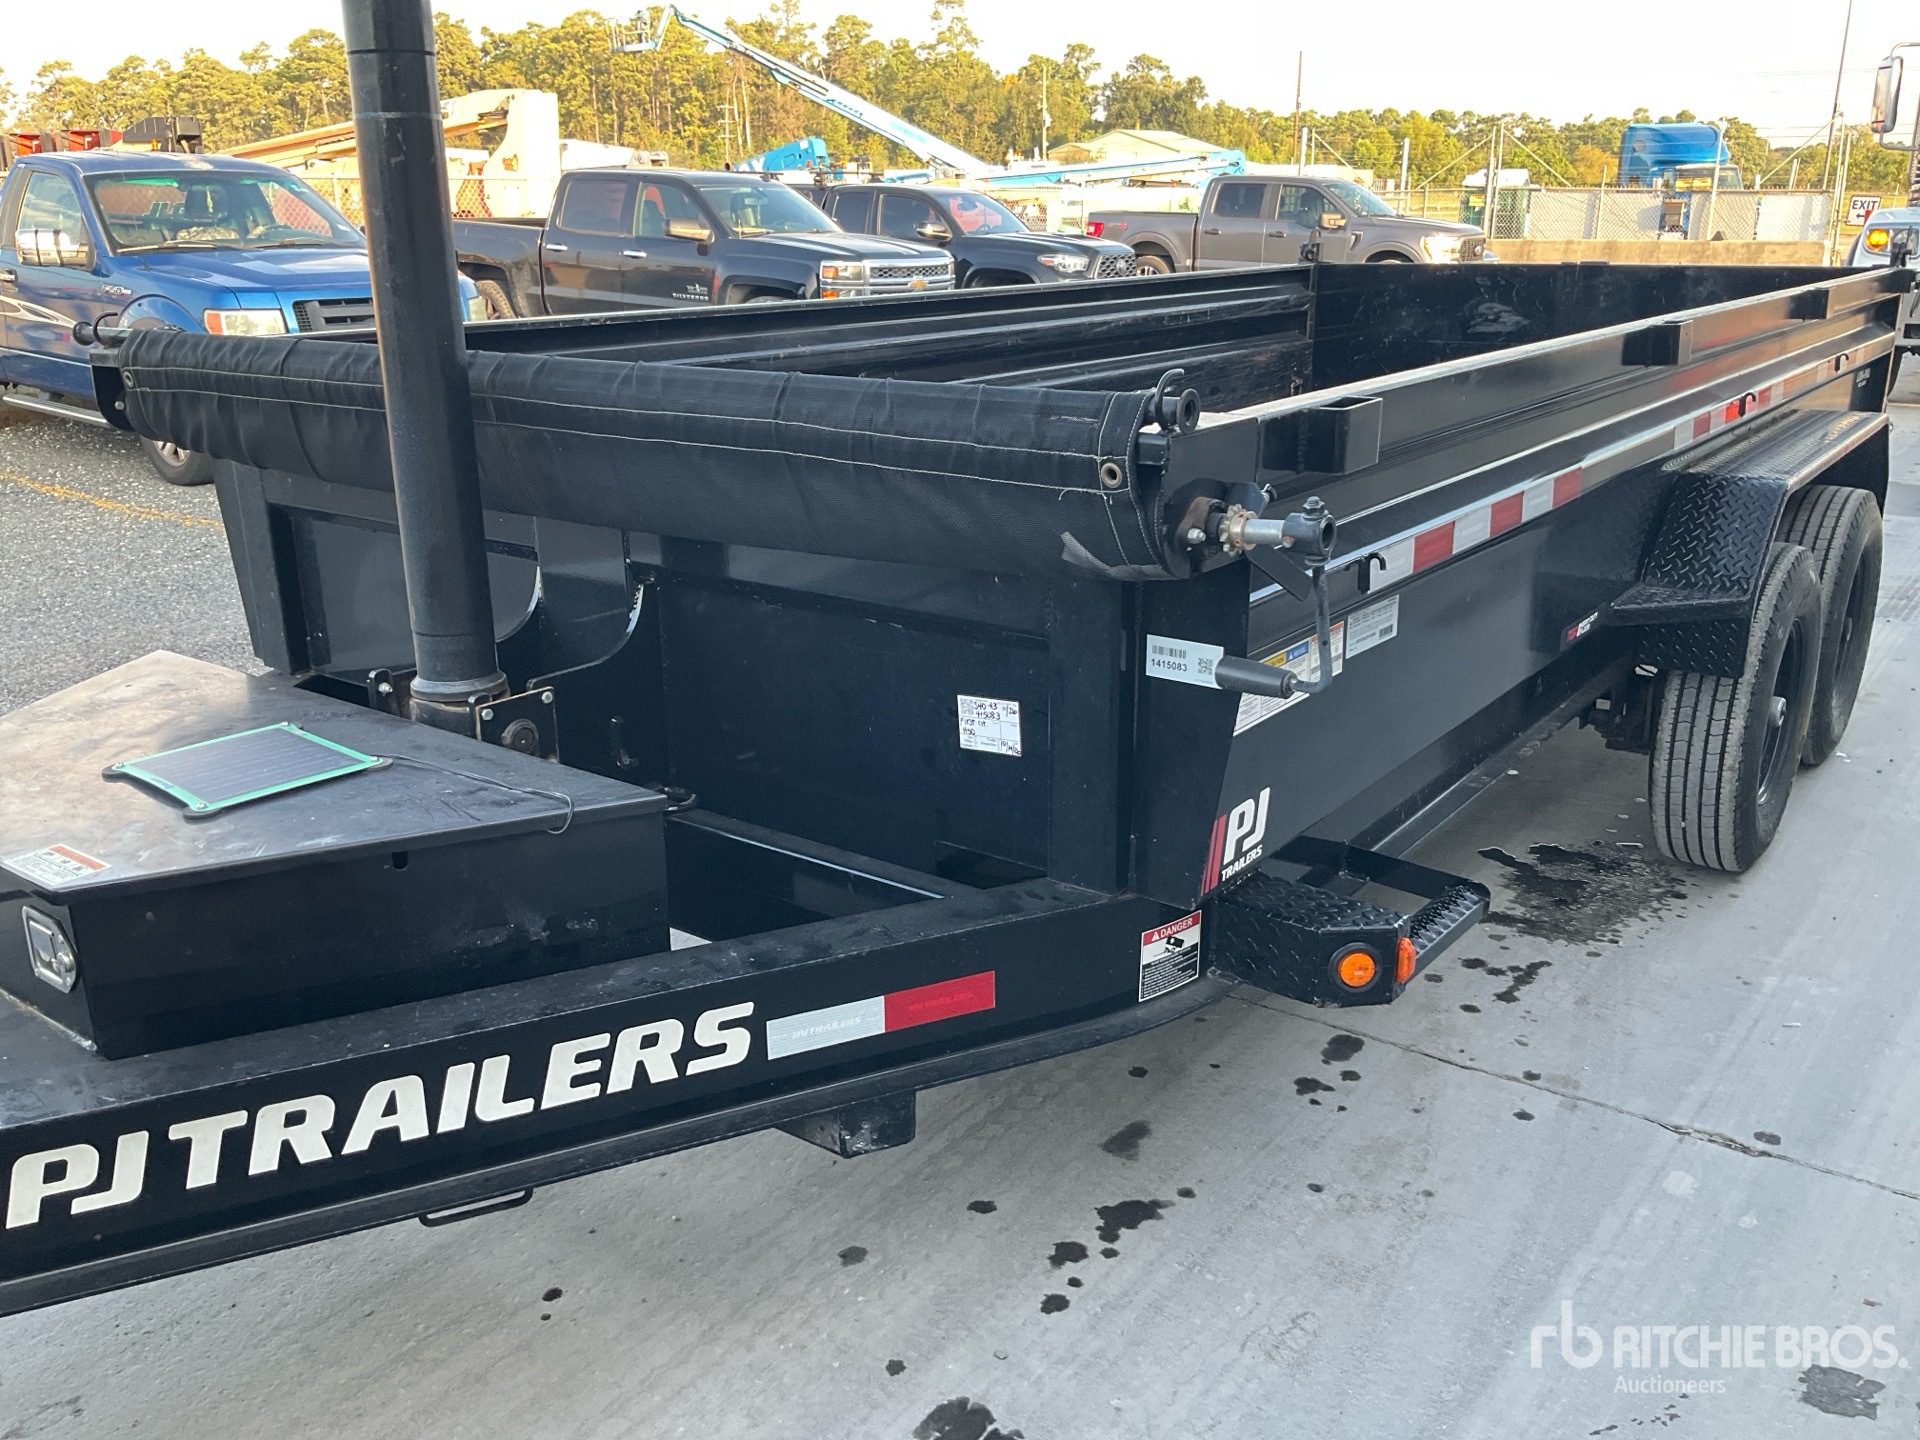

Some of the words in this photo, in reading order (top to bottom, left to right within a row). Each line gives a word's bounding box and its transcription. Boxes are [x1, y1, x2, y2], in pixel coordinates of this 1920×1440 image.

[1852, 199, 1878, 210] EXIT
[672, 292, 709, 301] SILVERADO
[1151, 658, 1188, 672] 1415083
[1223, 786, 1271, 866] PJ
[1221, 844, 1263, 882] TRAILERS
[1160, 917, 1193, 938] DANGER
